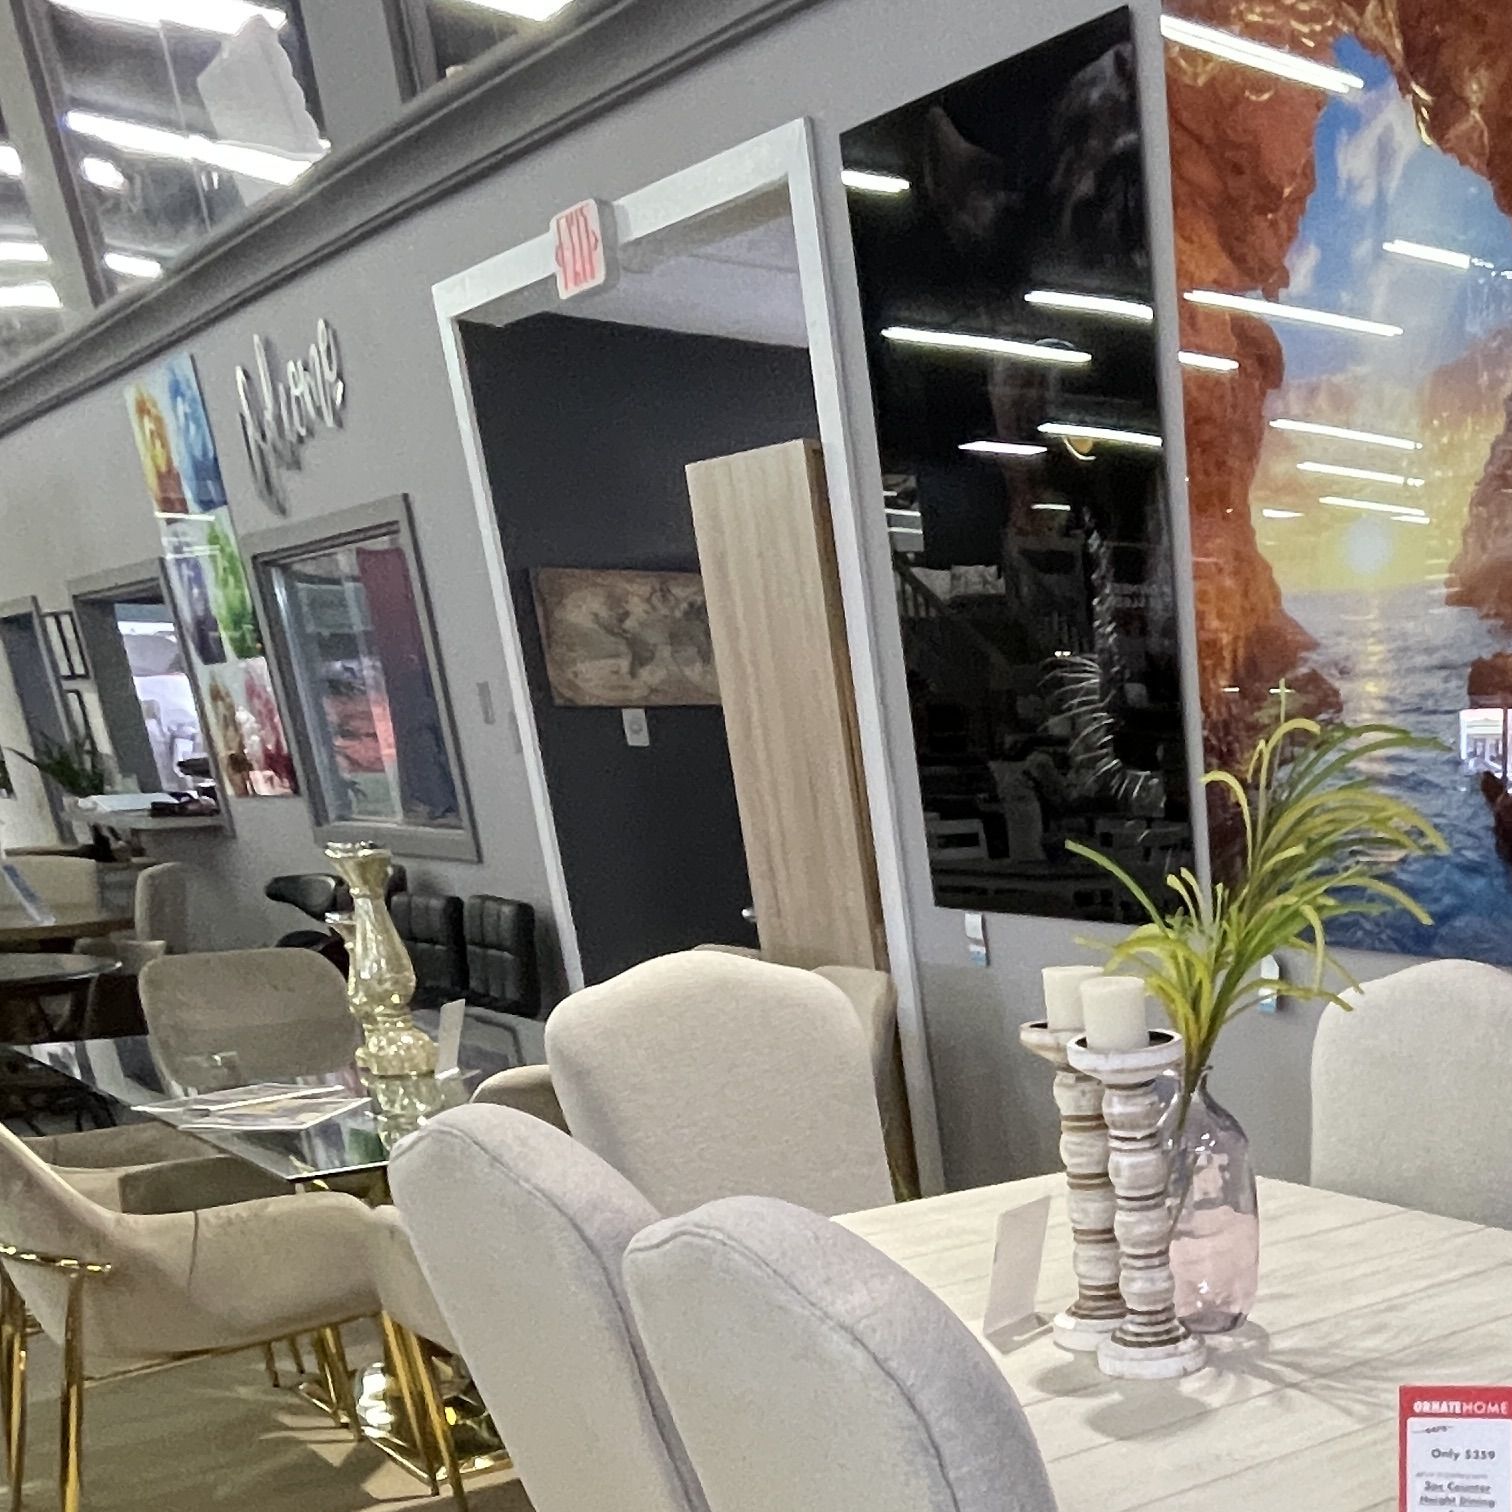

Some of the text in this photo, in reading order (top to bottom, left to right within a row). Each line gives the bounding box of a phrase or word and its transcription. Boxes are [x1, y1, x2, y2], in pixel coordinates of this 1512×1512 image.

[556, 205, 595, 290] EXIT
[1431, 1448, 1460, 1461] Only
[1447, 1481, 1491, 1494] Counter
[1419, 1495, 1496, 1508] Height Dining
